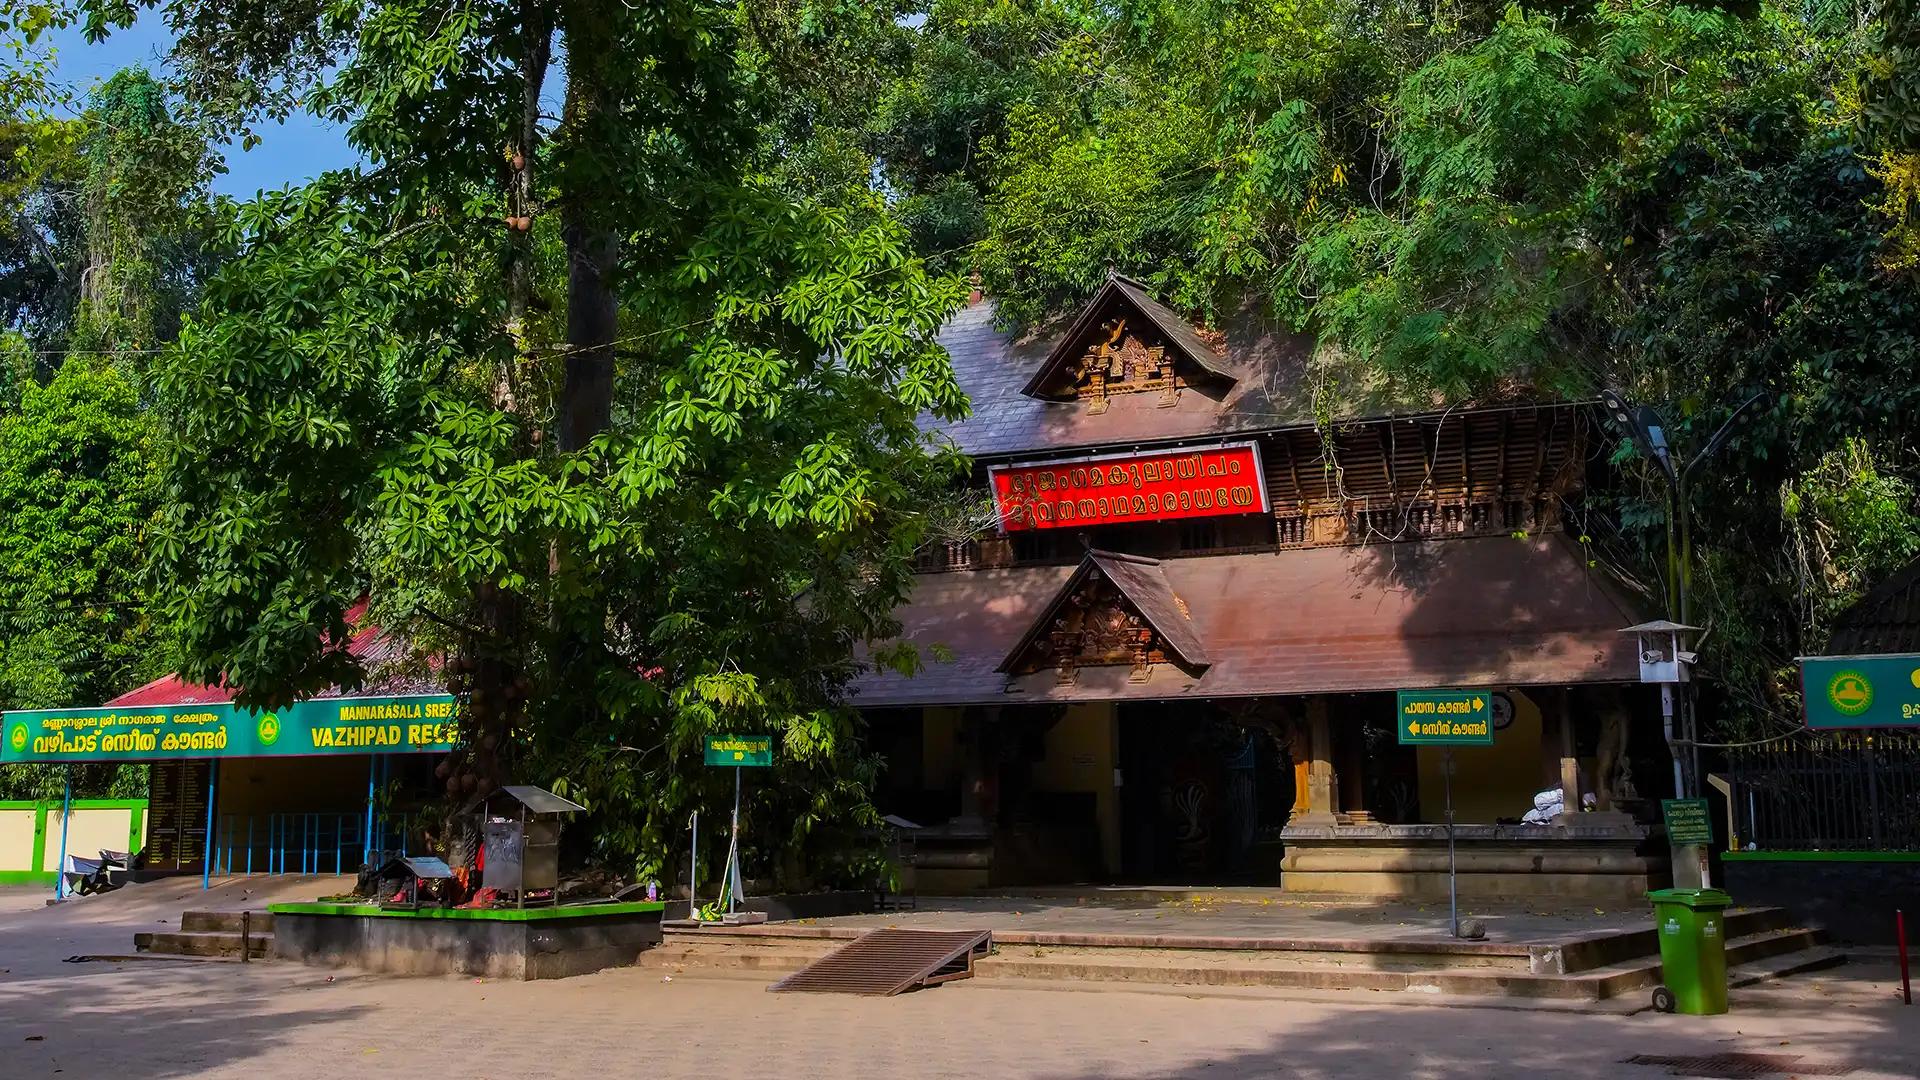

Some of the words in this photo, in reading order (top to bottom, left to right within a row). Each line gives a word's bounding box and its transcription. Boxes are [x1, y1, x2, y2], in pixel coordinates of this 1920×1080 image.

[1405, 702, 1435, 714] പായസ
[99, 714, 115, 728] ശ്രീ
[118, 714, 166, 726] നാഗരാജ
[33, 729, 102, 754] വഴിപാട്
[102, 728, 160, 752] രസീത്
[312, 725, 401, 747] VAZHIPAD
[408, 723, 461, 744] RECE
